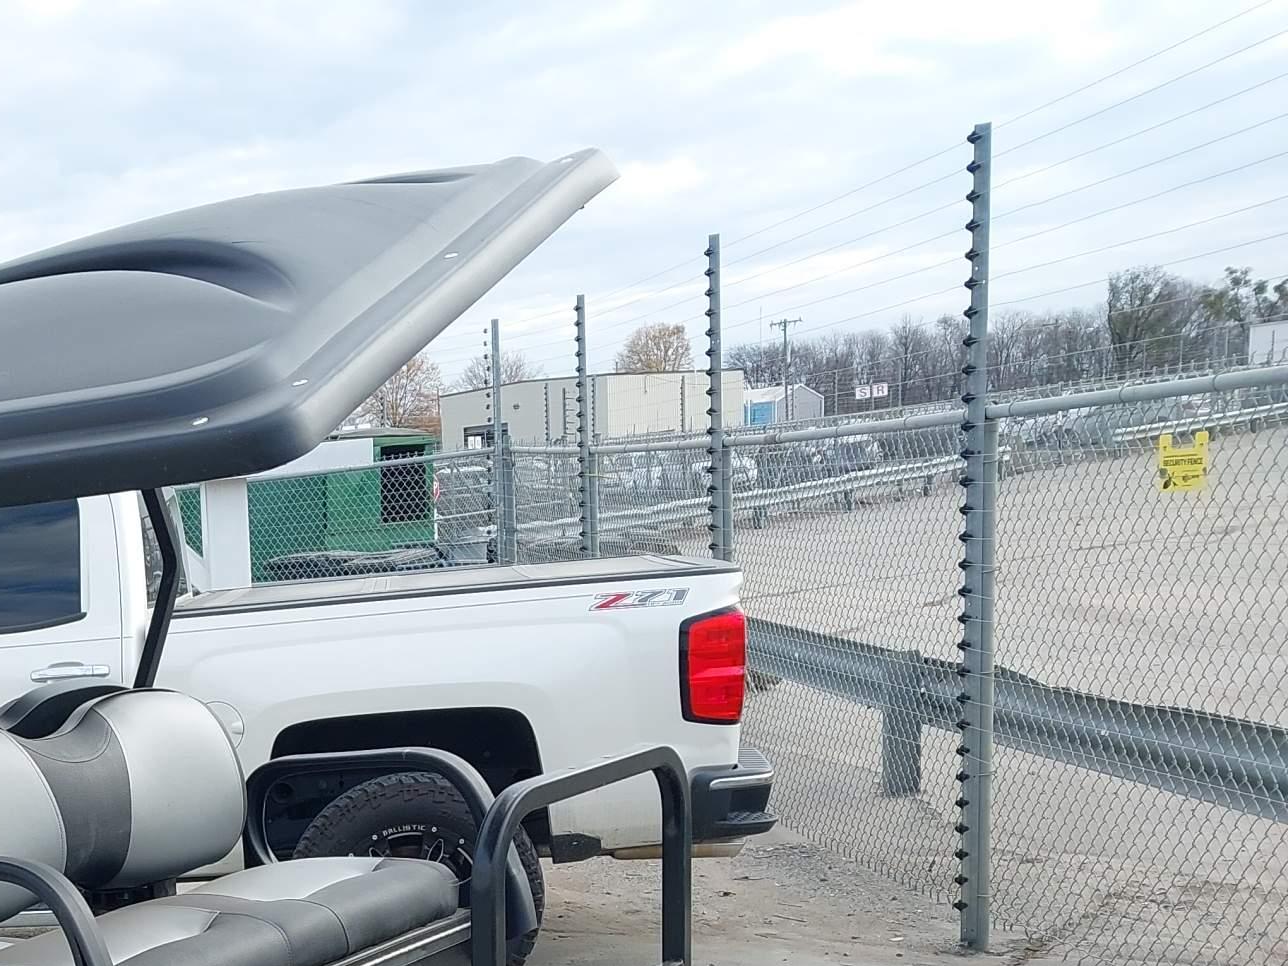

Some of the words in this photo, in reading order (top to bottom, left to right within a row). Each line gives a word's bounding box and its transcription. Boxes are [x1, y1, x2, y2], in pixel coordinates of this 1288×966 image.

[1163, 458, 1187, 467] SECURITY
[1187, 457, 1203, 465] FENCE
[588, 587, 690, 611] Z71
[382, 824, 427, 837] BALLISTIC
